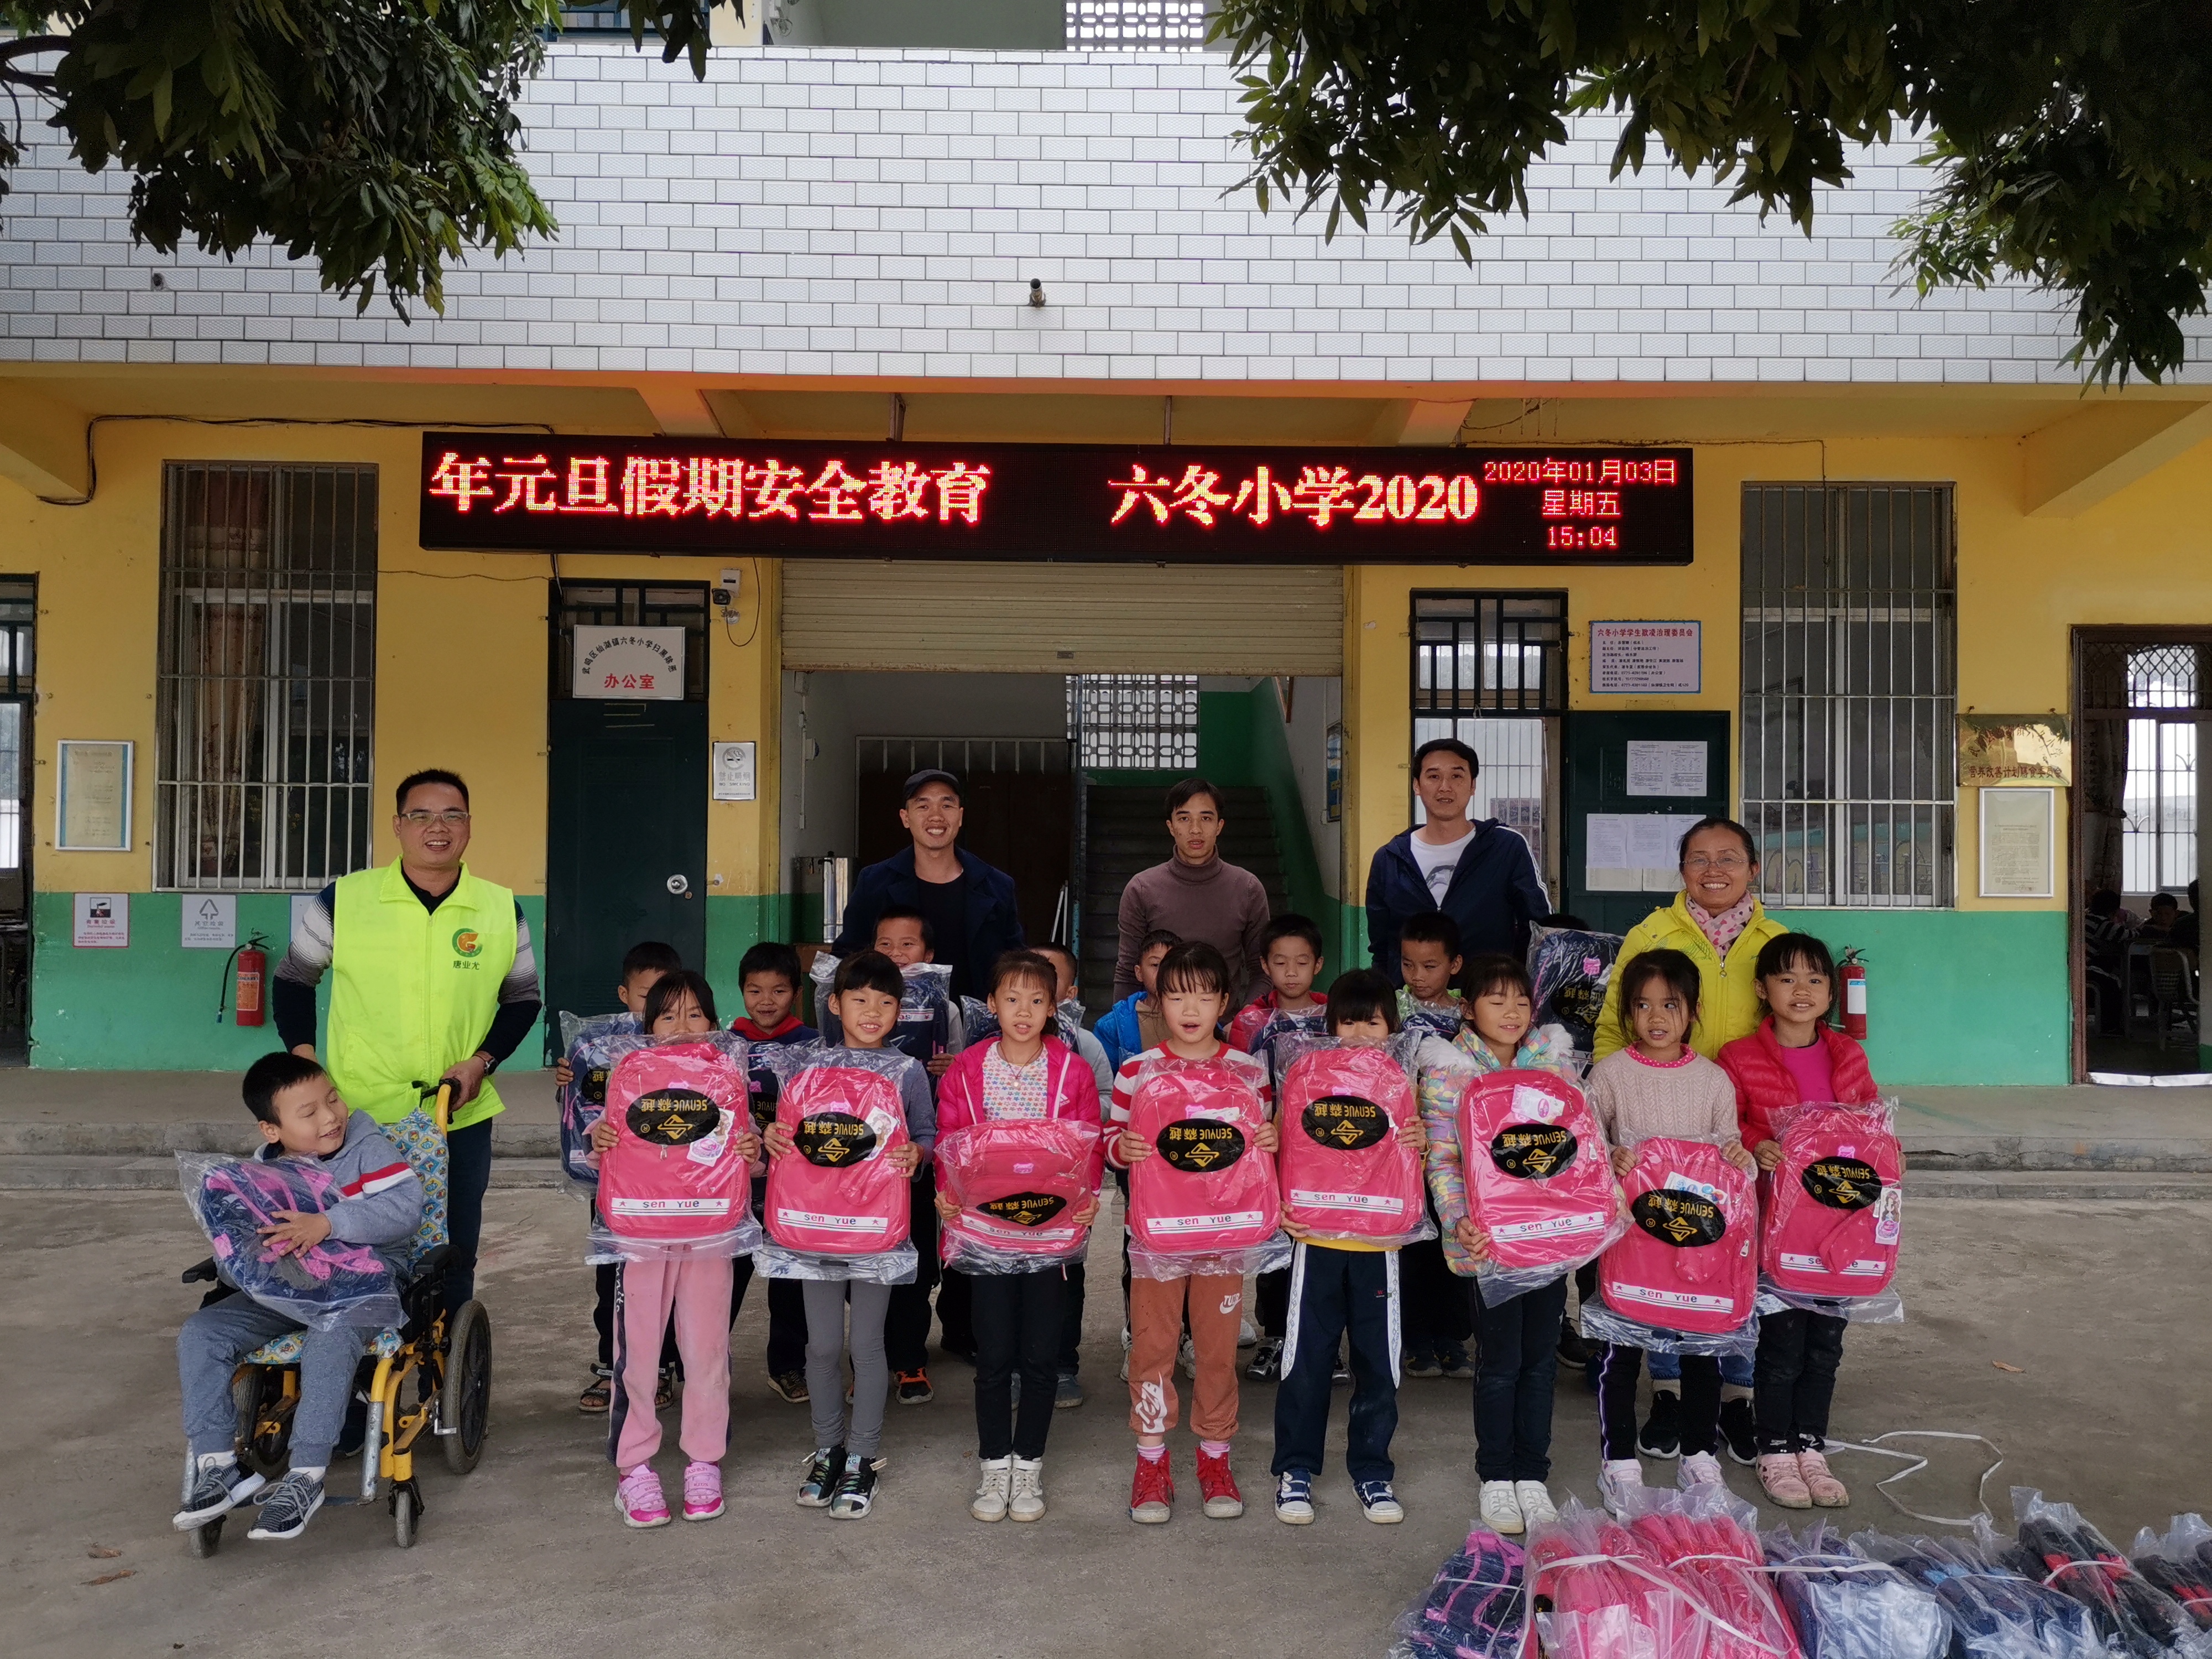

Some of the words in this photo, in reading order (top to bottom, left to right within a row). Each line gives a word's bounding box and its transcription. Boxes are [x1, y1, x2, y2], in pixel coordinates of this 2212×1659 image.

[1484, 457, 1676, 486] 2020年01月03日
[429, 452, 992, 523] 年元旦假期安全教育
[1108, 464, 1479, 526] 六冬小学2020
[1542, 489, 1620, 517] 星期五
[1548, 526, 1616, 547] 15:04
[604, 673, 655, 689] 办公室
[1969, 766, 2062, 778] 营养改善计划膳食委员会
[641, 1098, 671, 1112] 森越
[674, 1099, 707, 1112] SENYUE
[1314, 1103, 1343, 1118] 森越
[1344, 1105, 1376, 1118] SENYUE
[804, 1121, 832, 1135] 森越
[834, 1123, 864, 1136] SENYUE
[1168, 1126, 1198, 1141] 森越
[1199, 1127, 1233, 1140] SENYUE
[1502, 1133, 1532, 1147] 森越
[1533, 1130, 1567, 1145] SENYUE
[1841, 1167, 1870, 1179] SENYUE
[677, 1199, 700, 1208] Yue
[1021, 1197, 1054, 1209] SENYUE
[1314, 1193, 1335, 1201] sen
[1346, 1195, 1368, 1203] Yue
[1680, 1202, 1714, 1218] SENYUE
[804, 1213, 825, 1222] sen
[1177, 1217, 1199, 1226] sen
[1209, 1214, 1232, 1223] Yue
[1520, 1222, 1542, 1232] sen
[1551, 1217, 1572, 1227] Yue
[989, 1227, 1010, 1235] sen
[1639, 1287, 1662, 1299] sen
[1674, 1294, 1697, 1303] Yue
